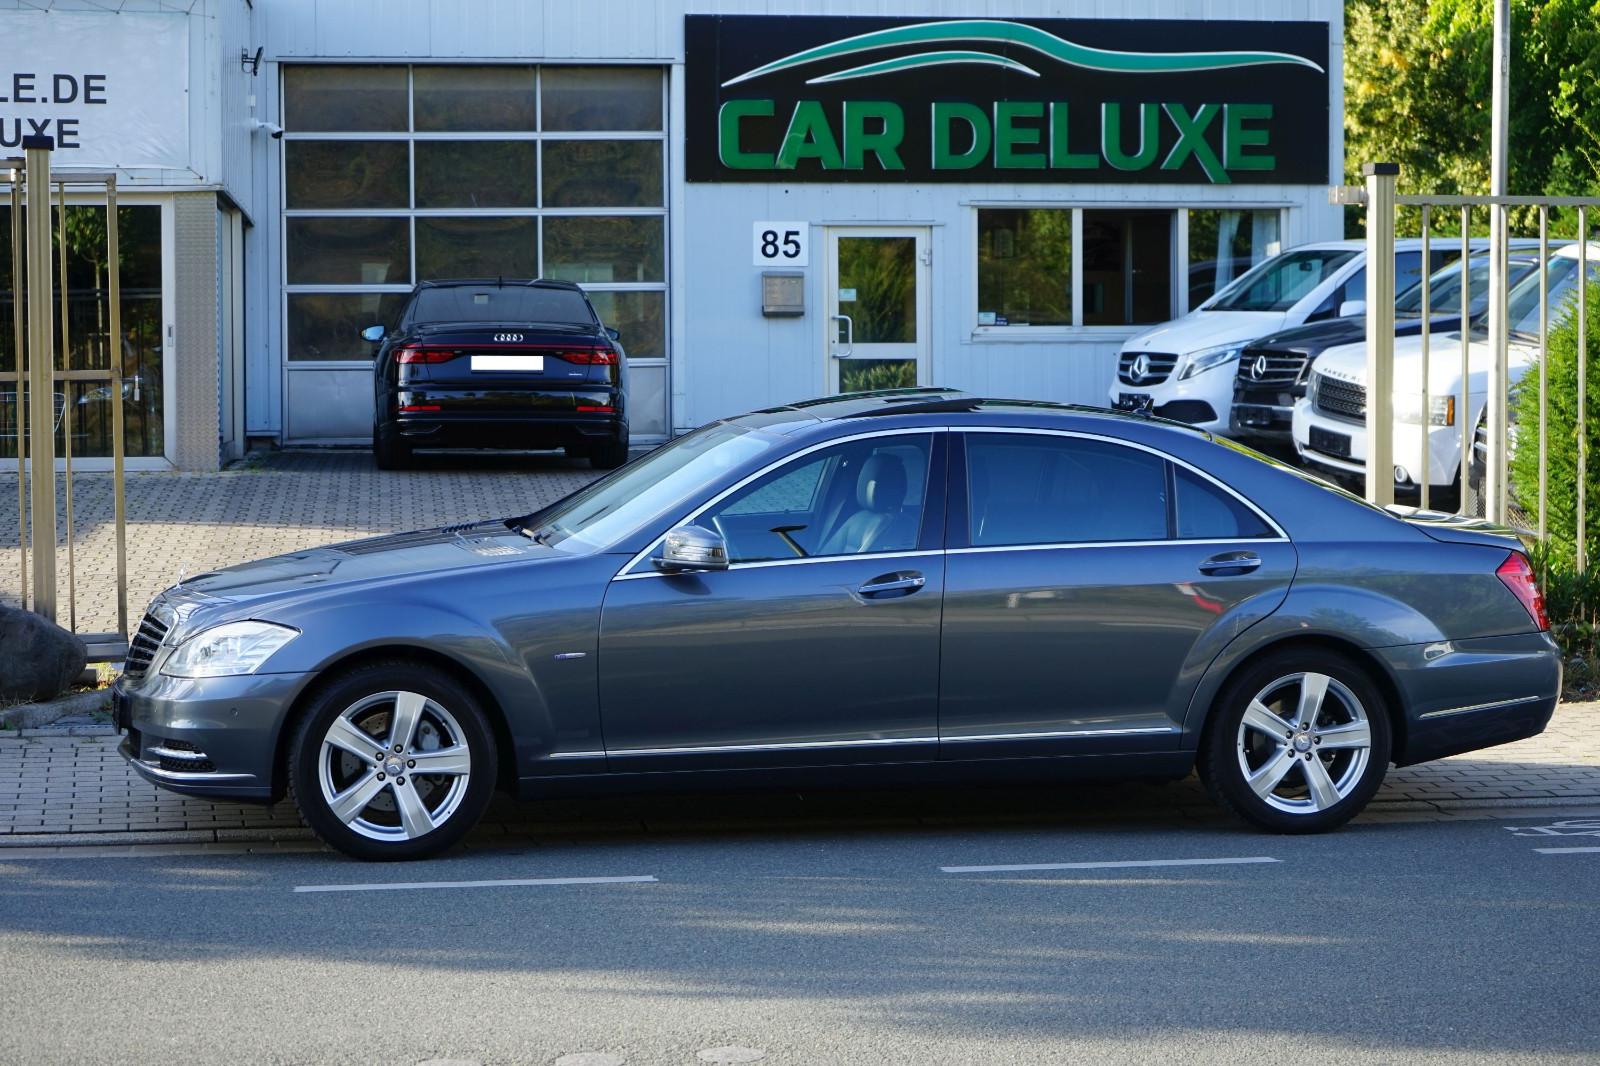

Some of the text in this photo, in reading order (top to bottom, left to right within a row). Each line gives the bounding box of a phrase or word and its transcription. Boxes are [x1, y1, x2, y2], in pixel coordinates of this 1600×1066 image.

[718, 99, 1276, 184] CAR DELUXE
[761, 229, 801, 259] 85
